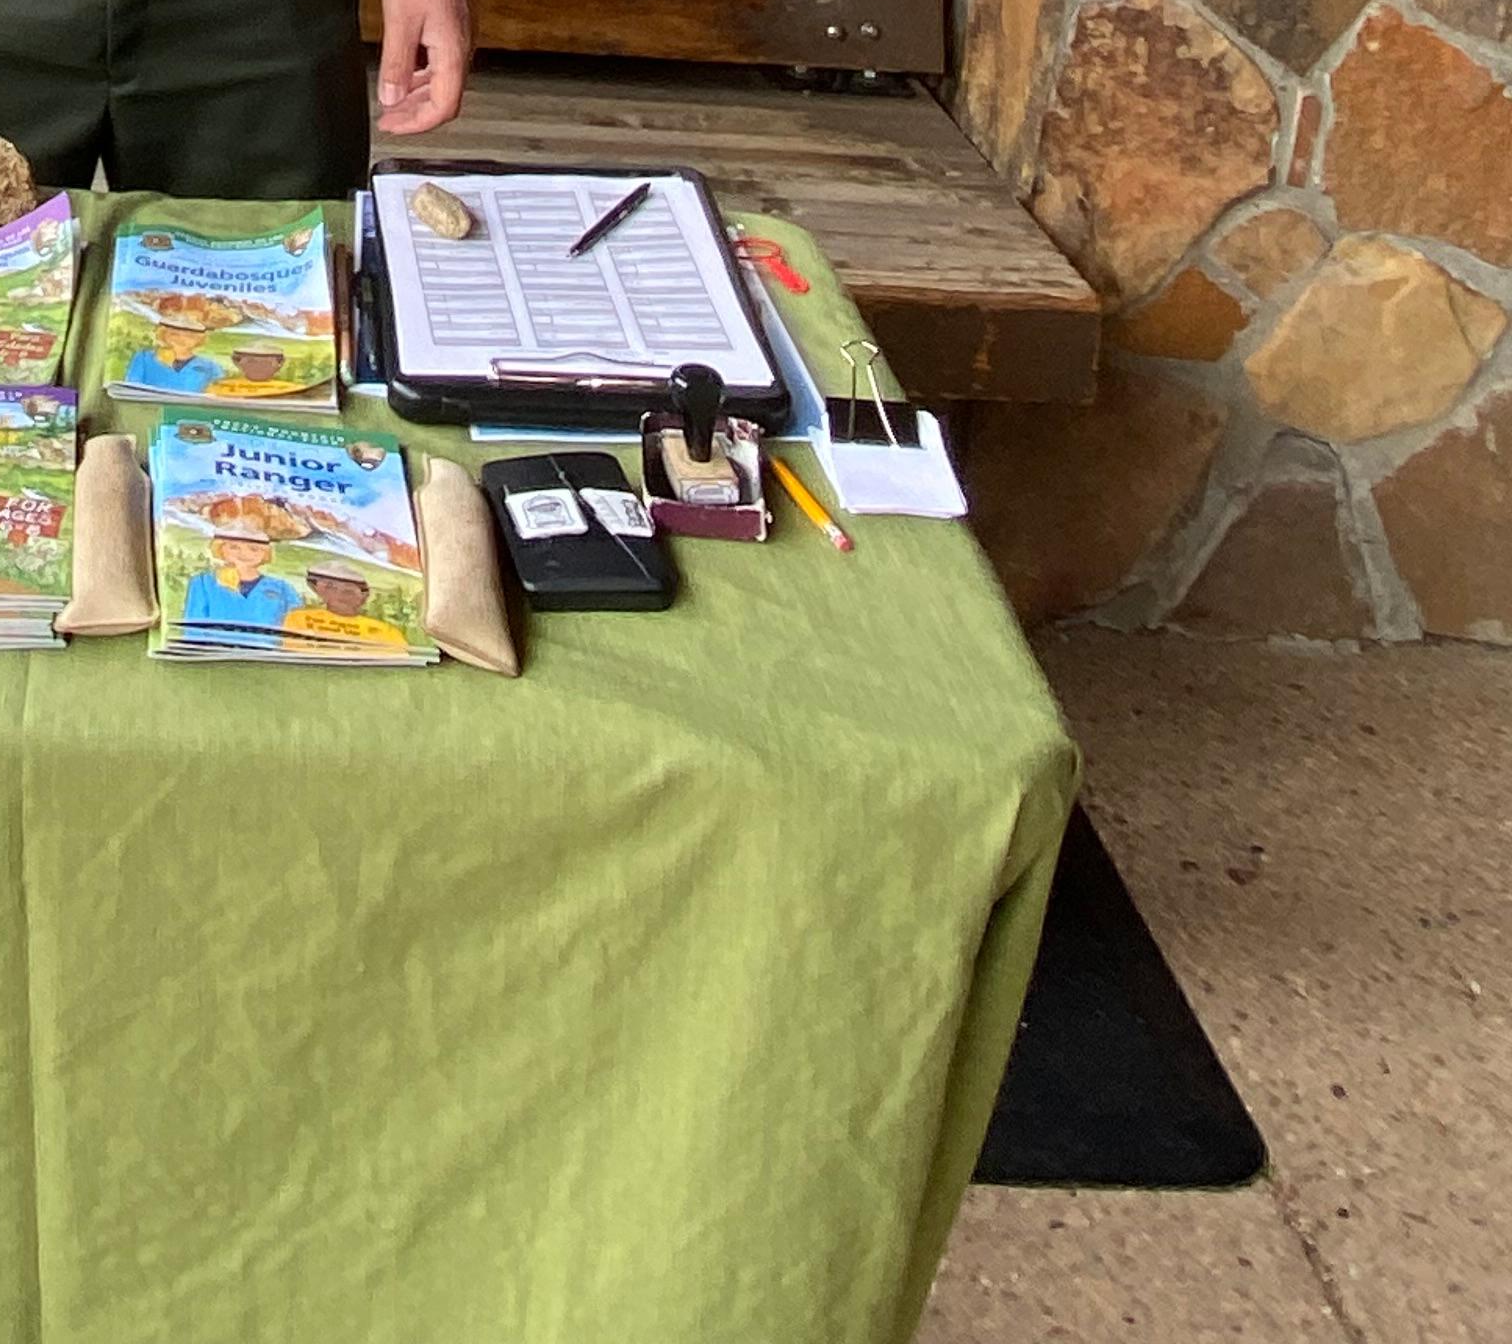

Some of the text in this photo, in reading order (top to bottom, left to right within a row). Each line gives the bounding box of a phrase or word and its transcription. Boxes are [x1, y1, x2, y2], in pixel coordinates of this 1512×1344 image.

[135, 255, 314, 282] Guardabosques
[171, 275, 278, 294] Juveniles
[221, 443, 342, 474] Junior
[215, 460, 353, 494] Ranger
